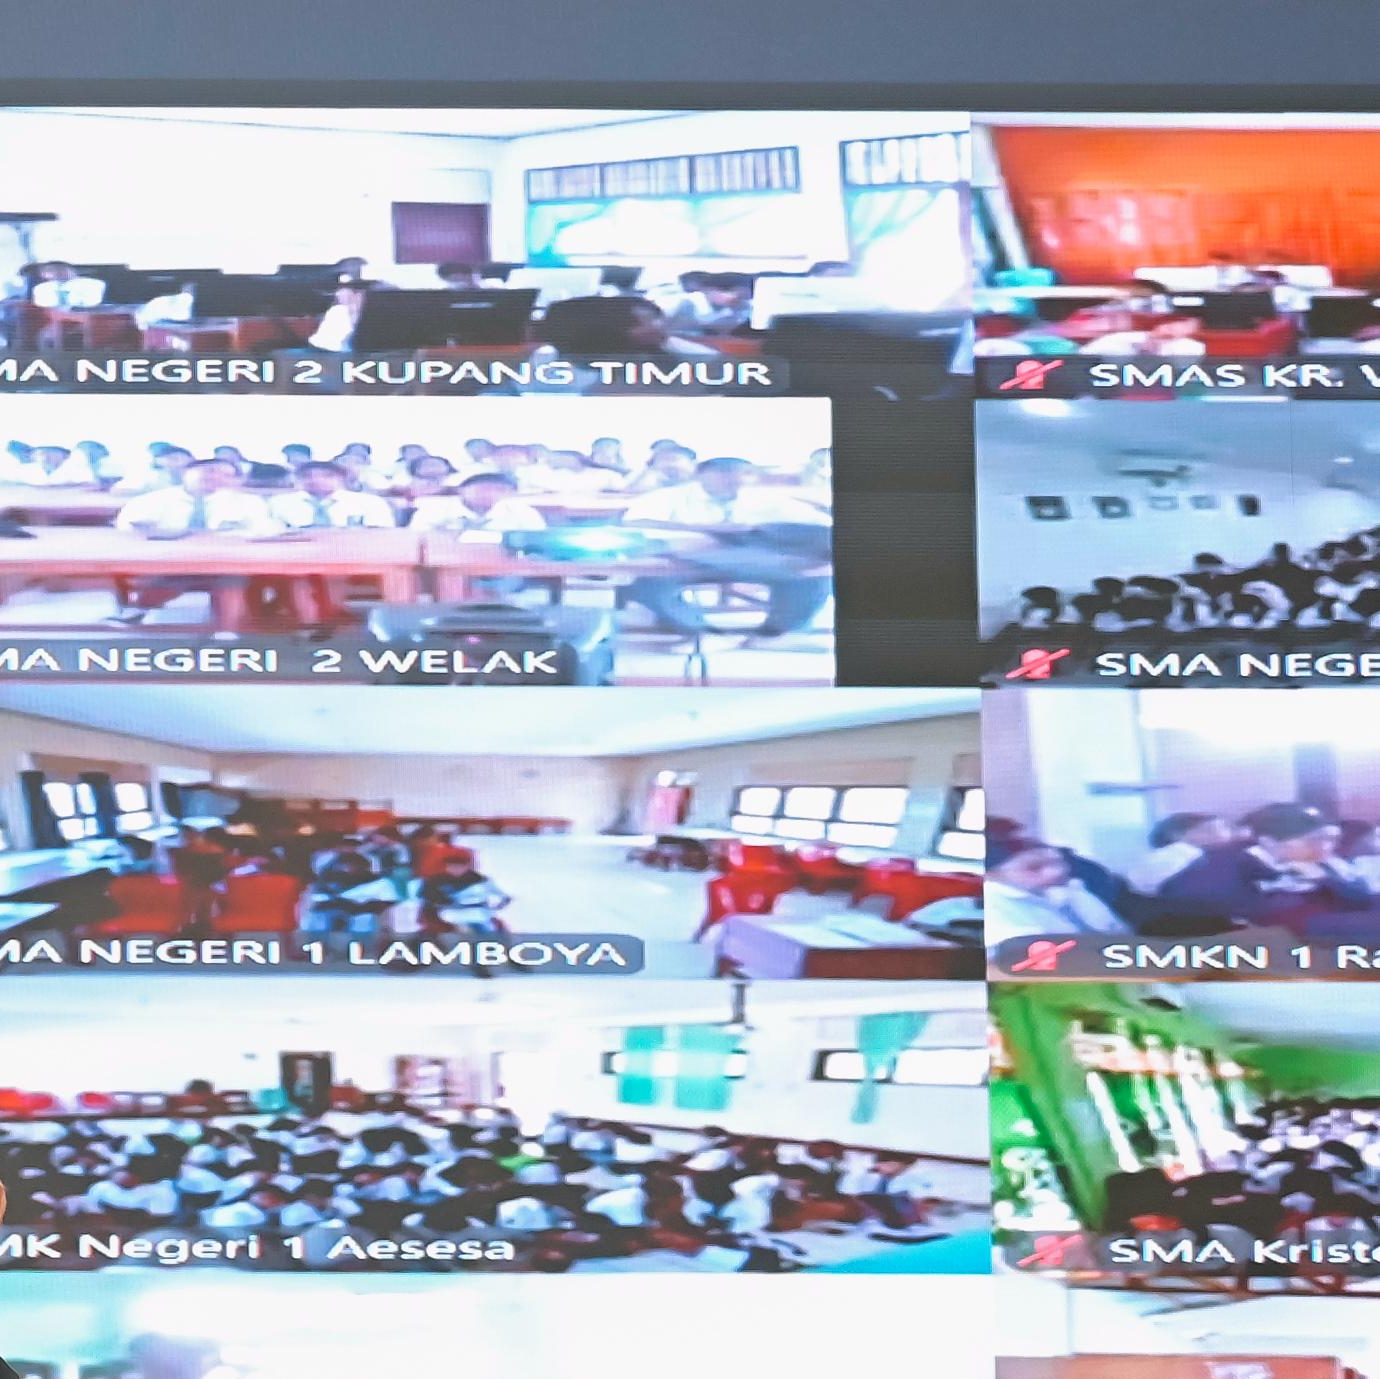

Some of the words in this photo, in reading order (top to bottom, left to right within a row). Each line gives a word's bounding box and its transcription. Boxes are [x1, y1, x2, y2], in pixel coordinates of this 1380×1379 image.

[76, 357, 276, 385] NEGERI
[293, 360, 324, 385] 2
[343, 360, 575, 388] KUPANG
[589, 360, 772, 388] TIMUR
[1090, 363, 1246, 389] SMAS
[1263, 363, 1345, 389] KR.
[79, 647, 279, 673] NEGERI
[313, 648, 342, 673] 2
[359, 648, 559, 676] WELAK
[1096, 651, 1223, 679] SMA
[80, 937, 280, 965] NEGERI
[303, 940, 324, 965] 1
[348, 940, 627, 968] LAMBOYA
[1103, 943, 1268, 971] SMKN
[1289, 944, 1313, 971] 1
[78, 1233, 260, 1266] Negeri
[284, 1235, 306, 1262] 1
[326, 1234, 515, 1264] Aesesa
[1110, 1237, 1236, 1266] SMA
